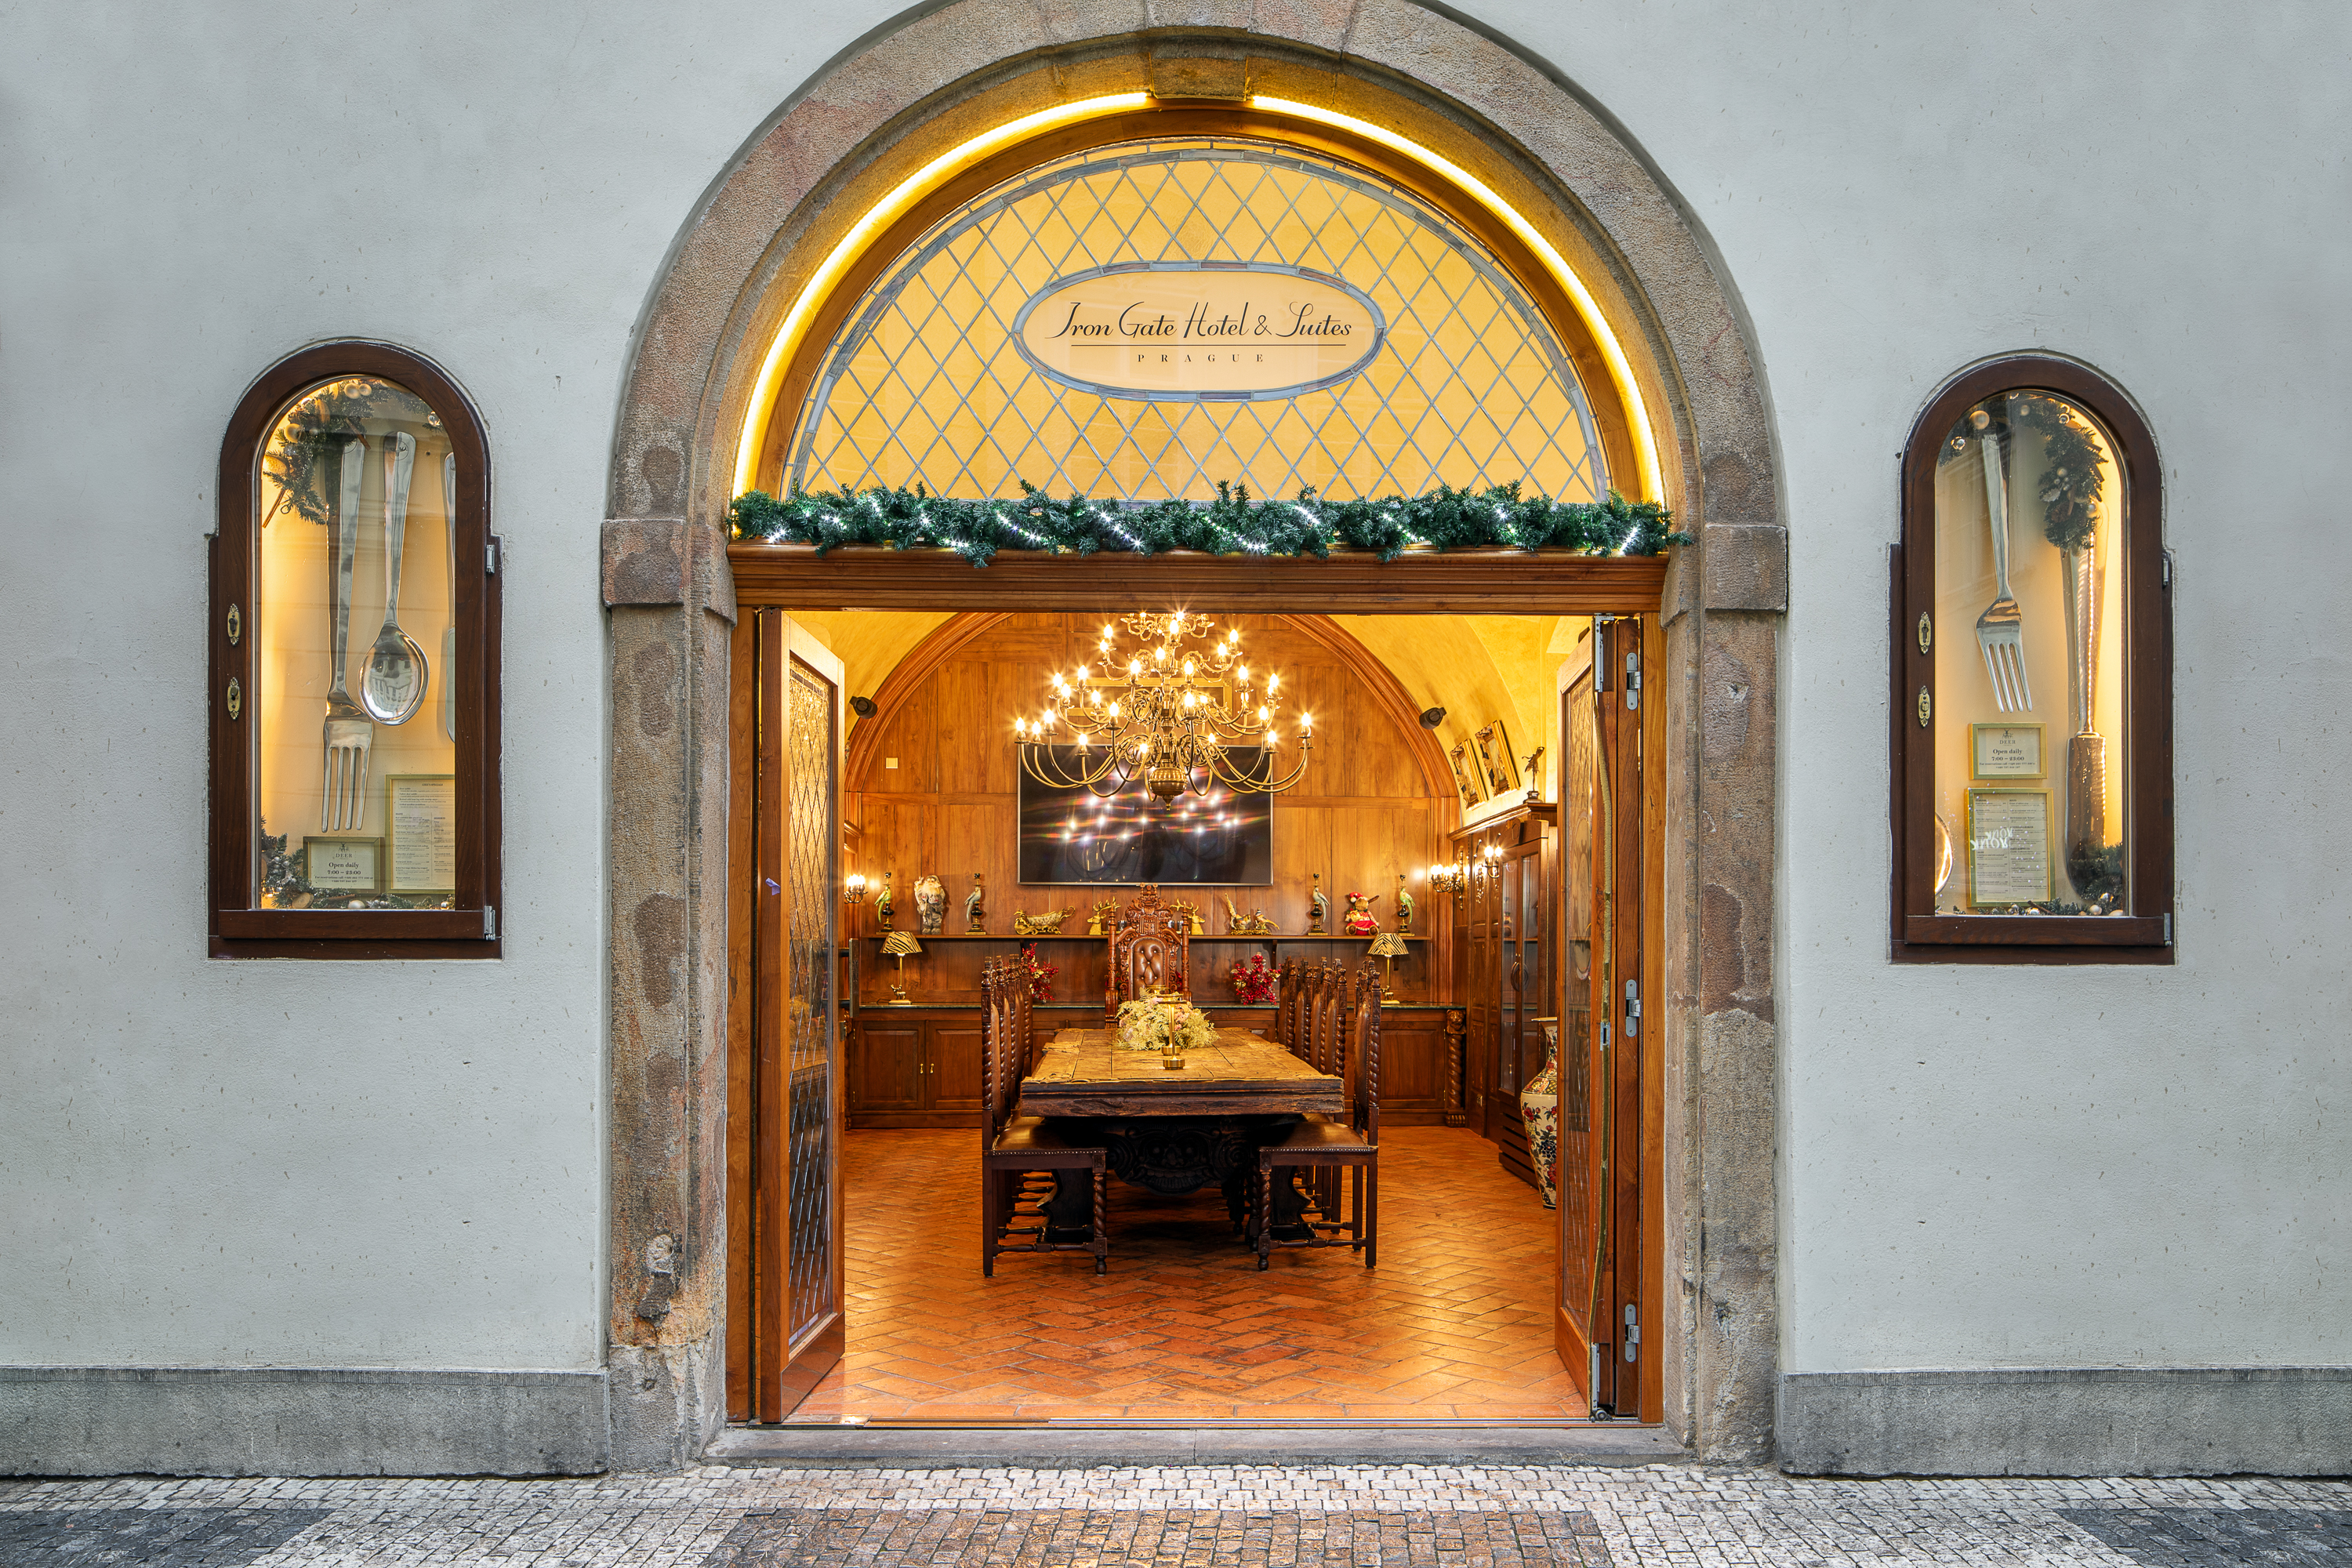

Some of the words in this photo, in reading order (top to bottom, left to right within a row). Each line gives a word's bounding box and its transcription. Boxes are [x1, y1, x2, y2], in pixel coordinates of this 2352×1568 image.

[1044, 301, 1113, 339] Iron
[1119, 301, 1178, 339] Gate
[1183, 301, 1250, 338] Hotel
[1254, 314, 1272, 336] &
[1275, 301, 1352, 338] Suites
